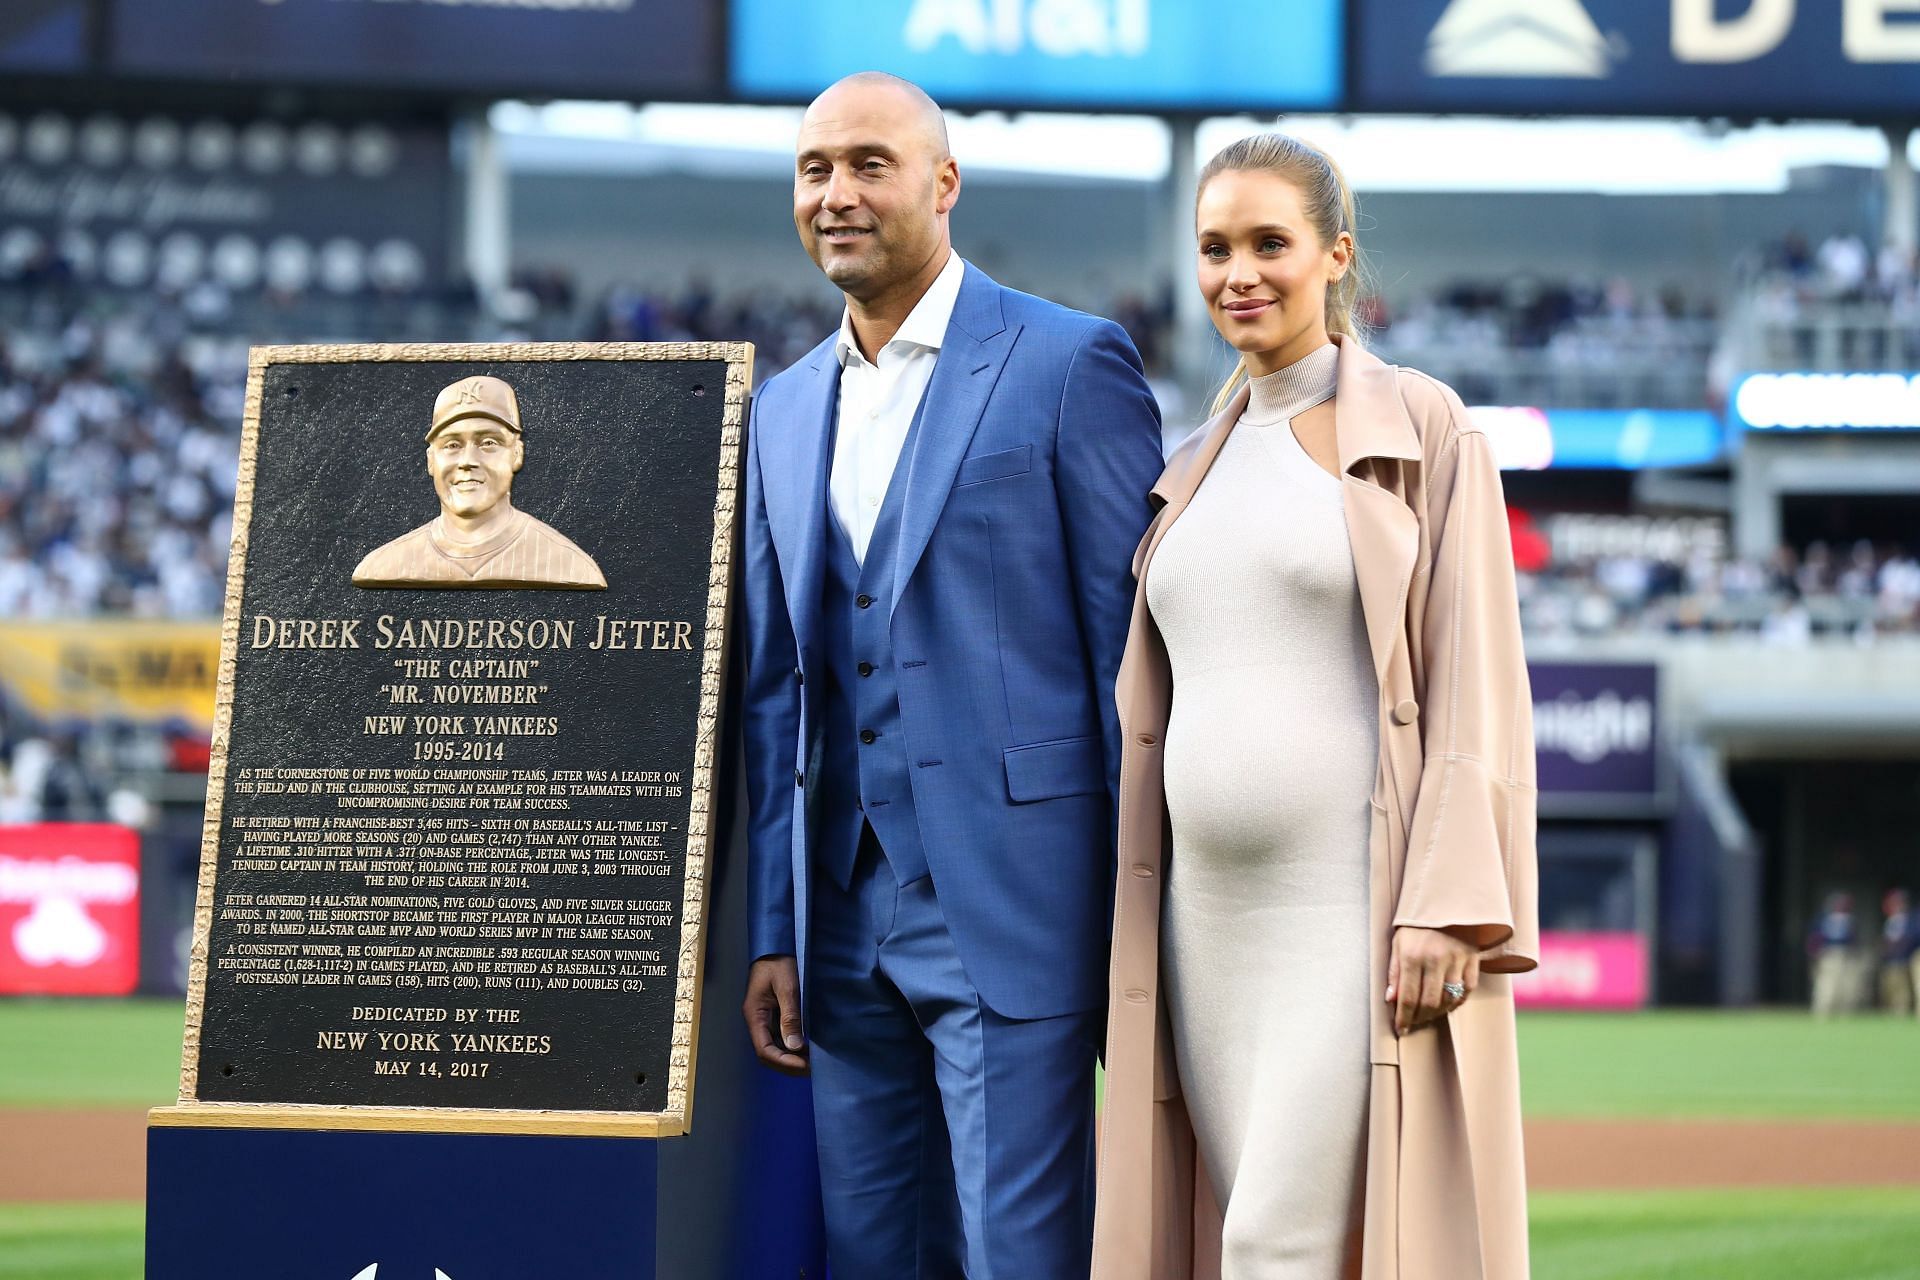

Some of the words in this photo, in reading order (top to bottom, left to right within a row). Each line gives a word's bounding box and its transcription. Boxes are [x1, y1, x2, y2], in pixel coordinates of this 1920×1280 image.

[252, 616, 359, 649] DEREK
[376, 614, 575, 650] SANDERSON
[589, 616, 693, 651] JETER
[364, 716, 406, 735] NEW
[413, 716, 464, 736] YORK
[474, 718, 558, 737] YANKEES
[414, 741, 504, 761] 1995-2014
[277, 769, 349, 780] CORNERSTONE
[368, 769, 391, 781] FIVE
[394, 769, 430, 781] WORLD
[433, 770, 508, 781] CHAMPIONSHIP
[511, 770, 548, 783] TEAMS,
[552, 770, 582, 782] JETER
[586, 771, 607, 782] WAS
[621, 771, 661, 782] LEADER
[234, 783, 254, 794] THE
[256, 783, 284, 794] FIELD
[287, 783, 308, 794] AND
[348, 784, 409, 797] CLUBHOUSE,
[413, 784, 455, 796] SETTING
[476, 785, 523, 796] EXAMPLE
[526, 785, 546, 796] FOR
[549, 785, 566, 797] HIS
[569, 785, 631, 797] TEAMMATES
[635, 786, 662, 797] WITH
[665, 786, 682, 798] HIS
[337, 797, 428, 809] UNCOMPROMISING
[431, 798, 466, 809] DESIRE
[469, 798, 490, 809] FOR
[493, 798, 521, 810] TEAM
[524, 798, 570, 810] SUCCESS.
[249, 817, 290, 829] RETIRED
[293, 817, 319, 829] WITH
[333, 818, 414, 830] FRANCHISE-BEST
[417, 819, 442, 831] 3,465
[446, 819, 469, 830] HITS
[481, 819, 510, 831] SIXTH
[595, 820, 642, 832] ALL-TIME
[646, 821, 667, 832] LIST
[243, 831, 280, 843] HAVING
[283, 832, 320, 843] PLAYED
[323, 832, 352, 844] MORE
[355, 832, 399, 844] SEASONS
[402, 833, 422, 846] (20)
[426, 833, 447, 844] AND
[450, 833, 485, 845] GAMES
[488, 834, 522, 846] (2,747)
[525, 834, 553, 845] THAN
[557, 834, 578, 846] ANY
[582, 834, 617, 846] OTHER
[620, 835, 662, 846] YANKEE.
[246, 846, 291, 857] LIFETIME
[294, 846, 315, 858] .310
[314, 846, 353, 858] HITTER
[356, 847, 382, 858] WITH
[396, 847, 415, 858] .377
[419, 847, 462, 859] ON-BASE
[465, 848, 532, 861] PERCENTAGE,
[536, 848, 566, 860] JETER
[570, 849, 591, 860] WAS
[618, 849, 668, 861] LONGEST-
[231, 860, 277, 871] TENURED
[280, 860, 322, 872] CAPTAIN
[339, 861, 367, 872] TEAM
[370, 861, 415, 874] HISTORY,
[418, 862, 463, 873] HOLDING
[490, 863, 517, 874] ROLE
[520, 863, 549, 874] FROM
[553, 863, 578, 875] JUNE
[594, 864, 617, 875] 2003
[620, 864, 670, 876] THROUGH
[364, 875, 384, 886] THE
[387, 875, 408, 886] END
[428, 876, 444, 887] HIS
[447, 876, 487, 888] CAREER
[504, 877, 530, 888] 2014.
[224, 895, 253, 906] JETER
[256, 895, 306, 907] GARNERED
[323, 896, 368, 907] ALL-STAR
[370, 896, 440, 910] NOMINATIONS,
[443, 897, 465, 909] FIVE
[468, 897, 495, 909] GOLD
[497, 898, 538, 911] GLOVES,
[542, 898, 563, 910] AND
[566, 899, 588, 910] FIVE
[590, 899, 624, 911] SILVER
[626, 899, 671, 911] SLUGGER
[220, 909, 262, 921] AWARDS.
[279, 910, 304, 923] 2000,
[330, 910, 389, 922] SHORTSTOP
[393, 911, 434, 923] BECAME
[460, 912, 488, 924] FIRST
[491, 912, 529, 924] PLAYER
[547, 913, 582, 925] MAJOR
[585, 914, 625, 925] LEAGUE
[629, 914, 672, 926] HISTORY
[270, 924, 305, 935] NAMED
[308, 924, 354, 936] ALL-STAR
[357, 925, 386, 936] GAME
[389, 925, 411, 937] MVP
[414, 926, 436, 937] AND
[439, 926, 476, 938] WORLD
[479, 927, 512, 938] SERIES
[516, 927, 538, 939] MVP
[579, 928, 608, 940] SAME
[611, 929, 654, 940] SEASON.
[237, 944, 298, 956] CONSISTENT
[301, 945, 343, 958] WINNER,
[364, 946, 415, 958] COMPILED
[436, 947, 495, 959] INCREDIBLE
[521, 948, 568, 960] REGULAR
[571, 949, 611, 961] SEASON
[614, 950, 660, 961] WINNING
[218, 958, 281, 970] PERCENTAGE
[284, 959, 353, 973] (1,628-1,117-2)
[370, 961, 405, 972] GAMES
[408, 961, 448, 974] PLAYED,
[452, 962, 473, 973] AND
[494, 962, 537, 974] RETIRED
[619, 964, 667, 976] ALL-TIME
[235, 973, 298, 985] POSTSEASON
[302, 974, 340, 986] LEADER
[357, 975, 392, 987] GAMES
[395, 976, 423, 989] (158),
[426, 976, 449, 988] HITS
[453, 977, 481, 990] (200),
[485, 977, 512, 989] RUNS
[515, 978, 543, 991] (111),
[547, 978, 569, 990] AND
[572, 979, 619, 991] DOUBLES
[622, 980, 645, 993] (32).
[352, 1007, 447, 1022] DEDICATED
[456, 1008, 478, 1023] BY
[486, 1010, 520, 1024] THE
[316, 1032, 368, 1051] NEW
[378, 1033, 441, 1052] YORK
[450, 1034, 551, 1054] YANKEES
[374, 1060, 411, 1076] MAY
[420, 1062, 442, 1078] 14,
[450, 1062, 489, 1078] 2017
